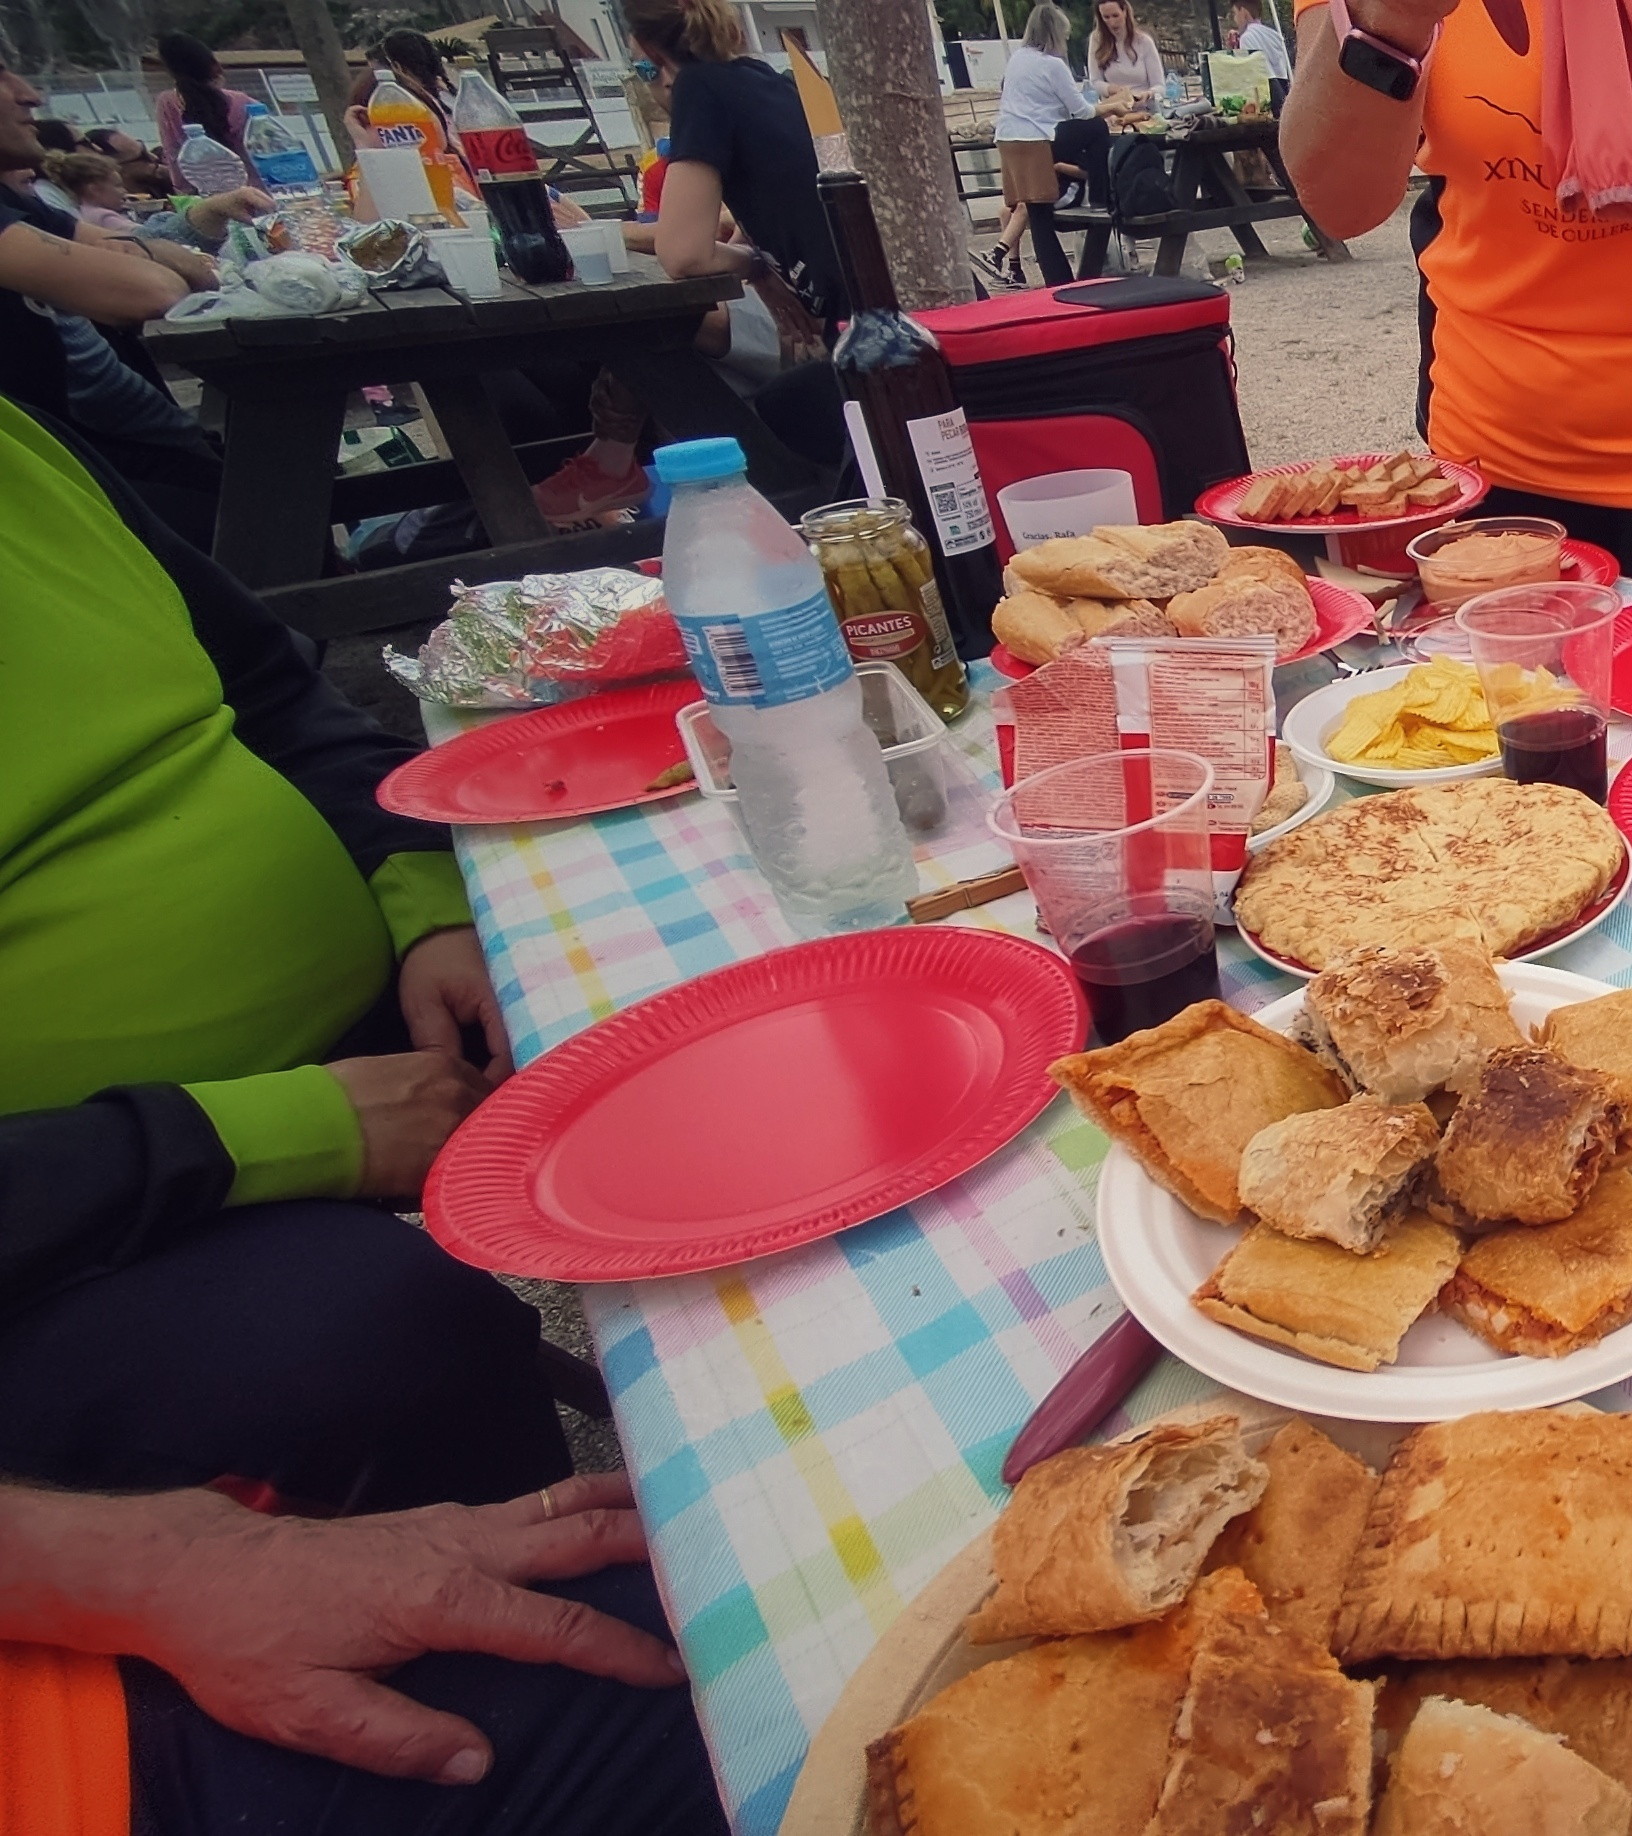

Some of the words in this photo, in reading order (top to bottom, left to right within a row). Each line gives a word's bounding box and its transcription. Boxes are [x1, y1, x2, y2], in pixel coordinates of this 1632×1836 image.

[379, 125, 425, 142] FANTA
[1534, 220, 1559, 239] DE
[845, 616, 912, 636] PICANTES
